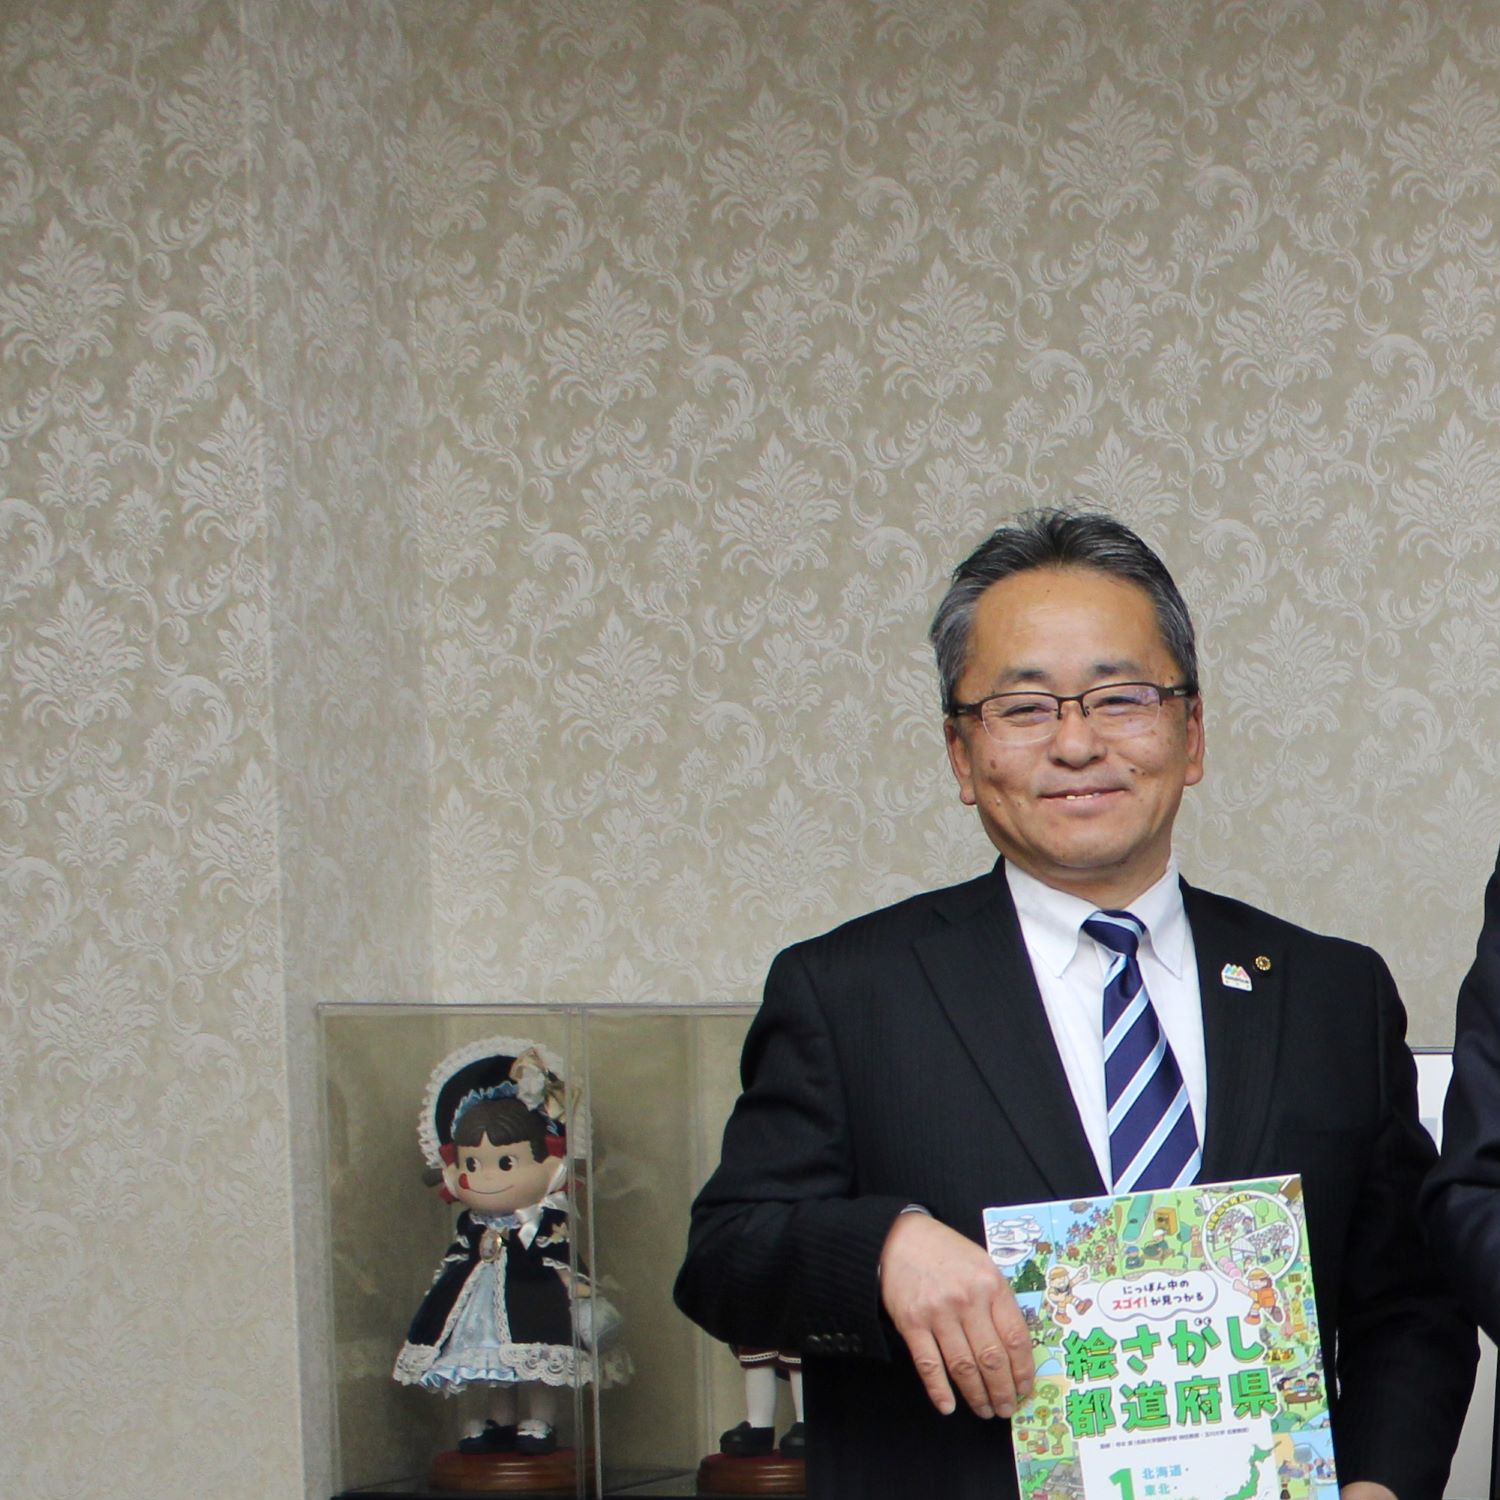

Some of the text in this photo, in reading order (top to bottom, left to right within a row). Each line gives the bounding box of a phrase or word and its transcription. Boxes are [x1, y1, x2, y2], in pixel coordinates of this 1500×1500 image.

[1123, 1279, 1189, 1295] にっぽん中の
[1063, 1316, 1265, 1382] 絵さがし
[1066, 1369, 1278, 1438] 都道府県
